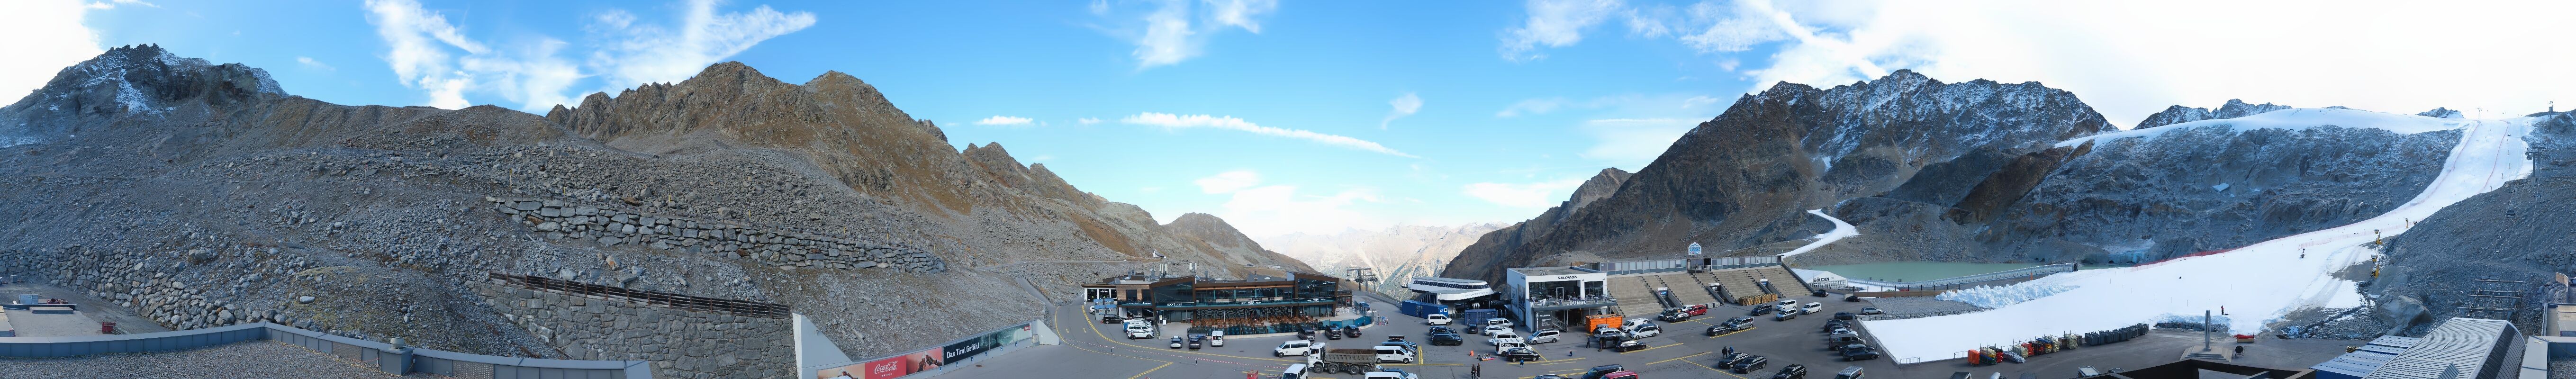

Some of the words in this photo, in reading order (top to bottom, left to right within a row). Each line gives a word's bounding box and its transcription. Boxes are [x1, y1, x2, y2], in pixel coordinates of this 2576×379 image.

[956, 348, 966, 356] Tirol
[966, 343, 979, 352] Gefühl
[874, 361, 898, 374] Coca-Cola
